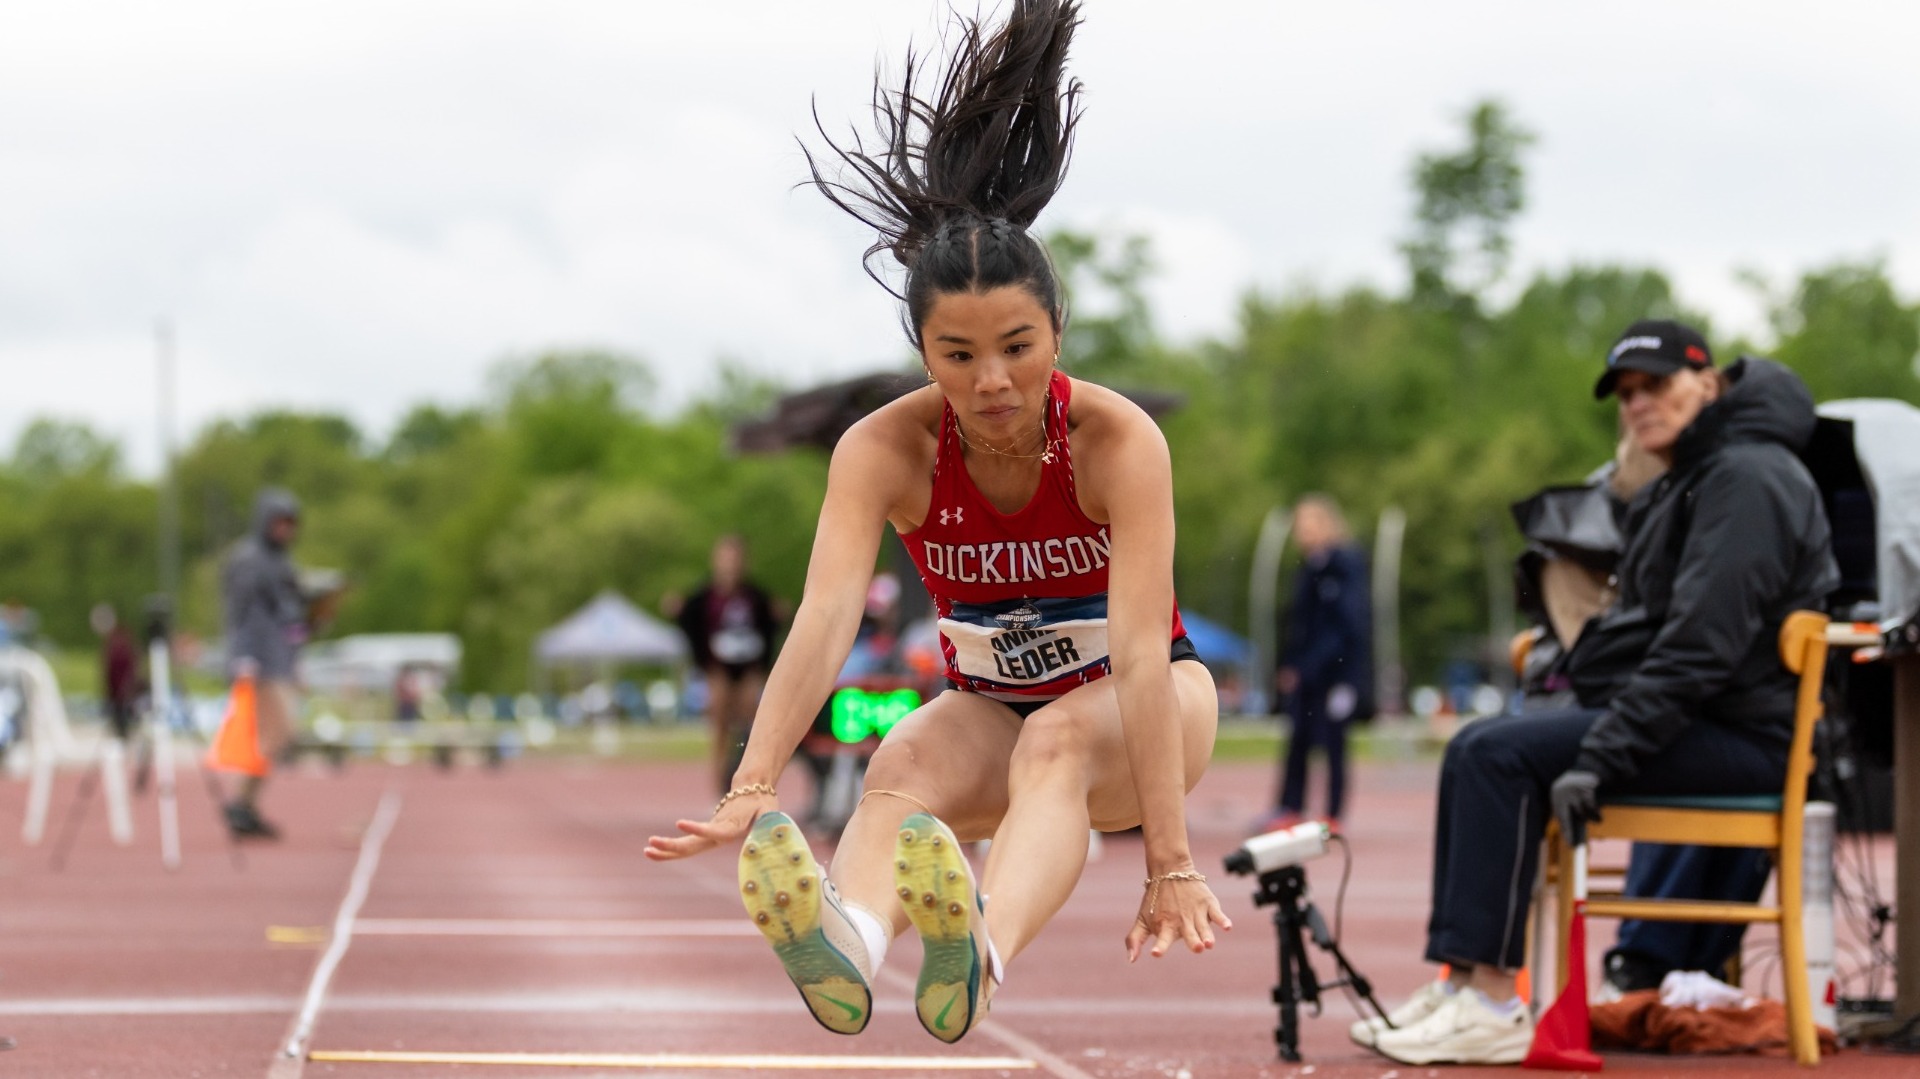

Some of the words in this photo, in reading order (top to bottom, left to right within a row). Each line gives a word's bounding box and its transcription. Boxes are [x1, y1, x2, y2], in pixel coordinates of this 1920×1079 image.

[923, 527, 1110, 584] DICKINSON
[995, 613, 1041, 622] CHAMPIONSHIPS
[993, 636, 1081, 680] LEDER
